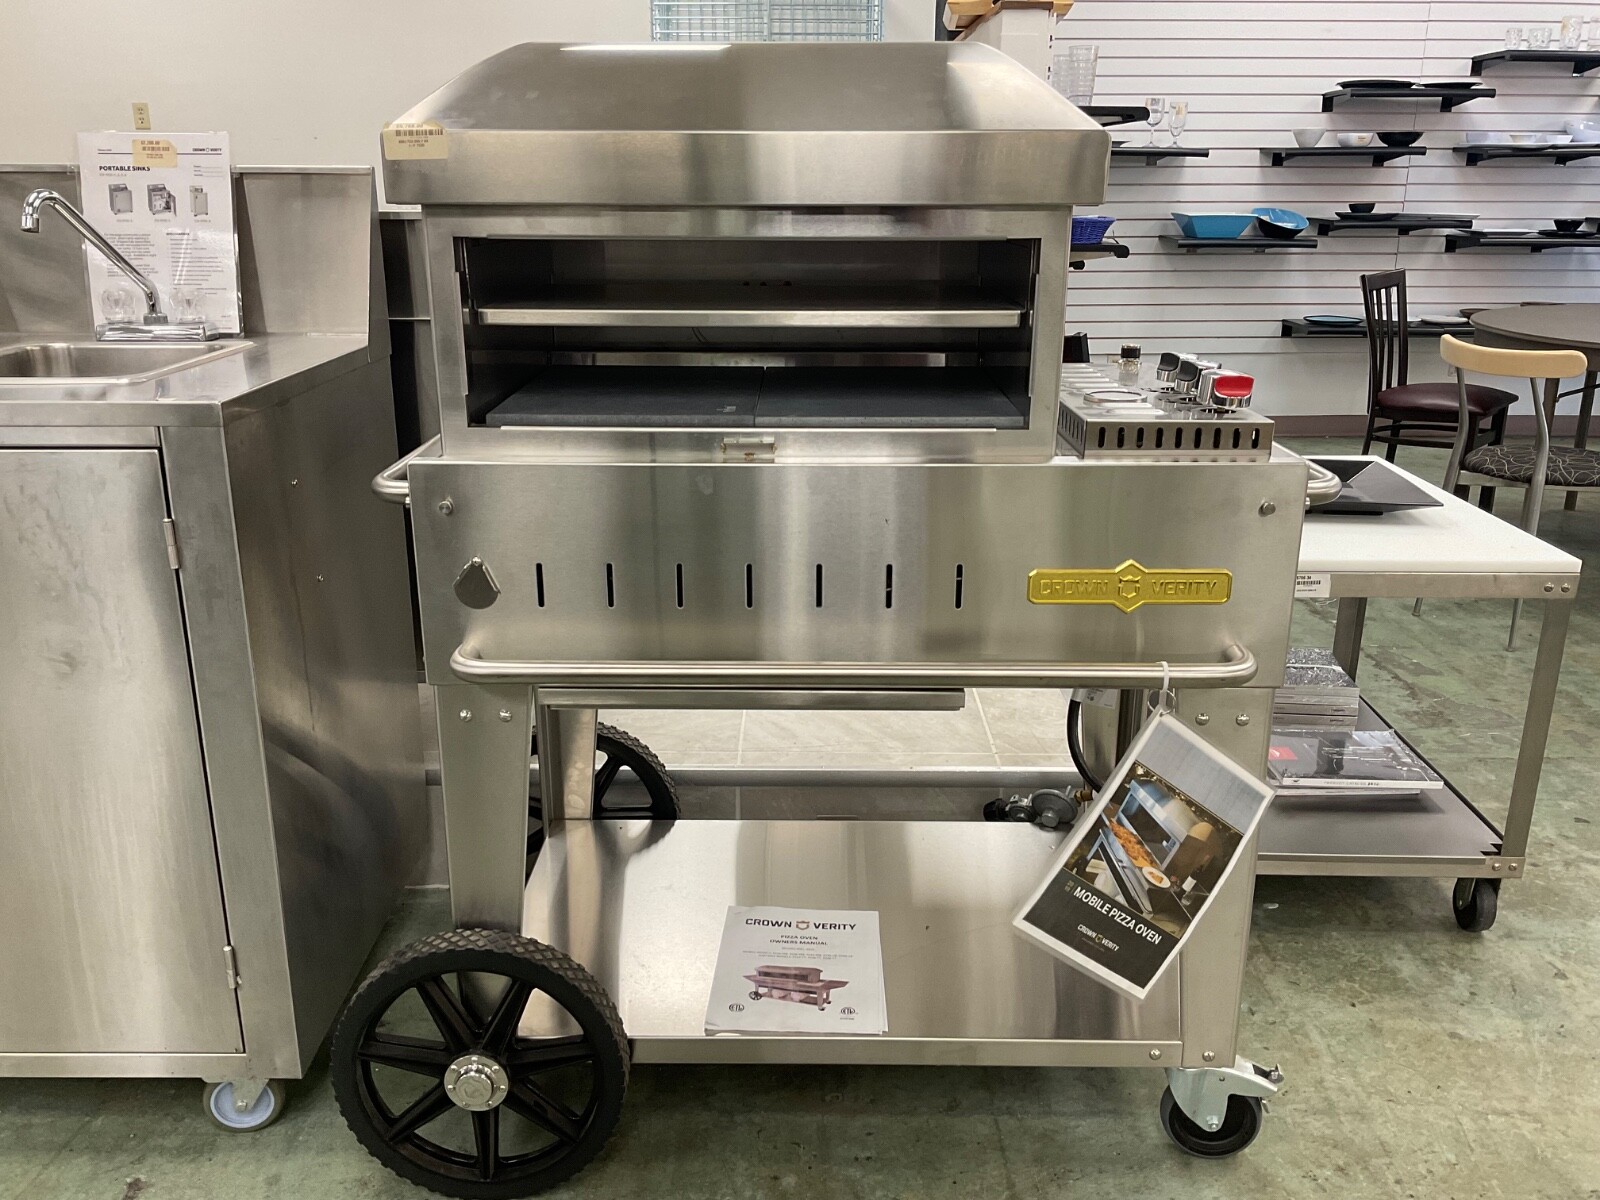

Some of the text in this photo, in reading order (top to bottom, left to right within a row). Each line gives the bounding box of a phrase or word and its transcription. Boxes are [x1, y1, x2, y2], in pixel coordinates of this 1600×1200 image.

[1040, 579, 1218, 596] CROWN VERITY
[745, 918, 857, 931] CROWN VERITY
[1073, 886, 1163, 945] MOBILE PIZZA OVEN
[1077, 923, 1098, 939] CROWN
[1101, 937, 1120, 952] VERITY
